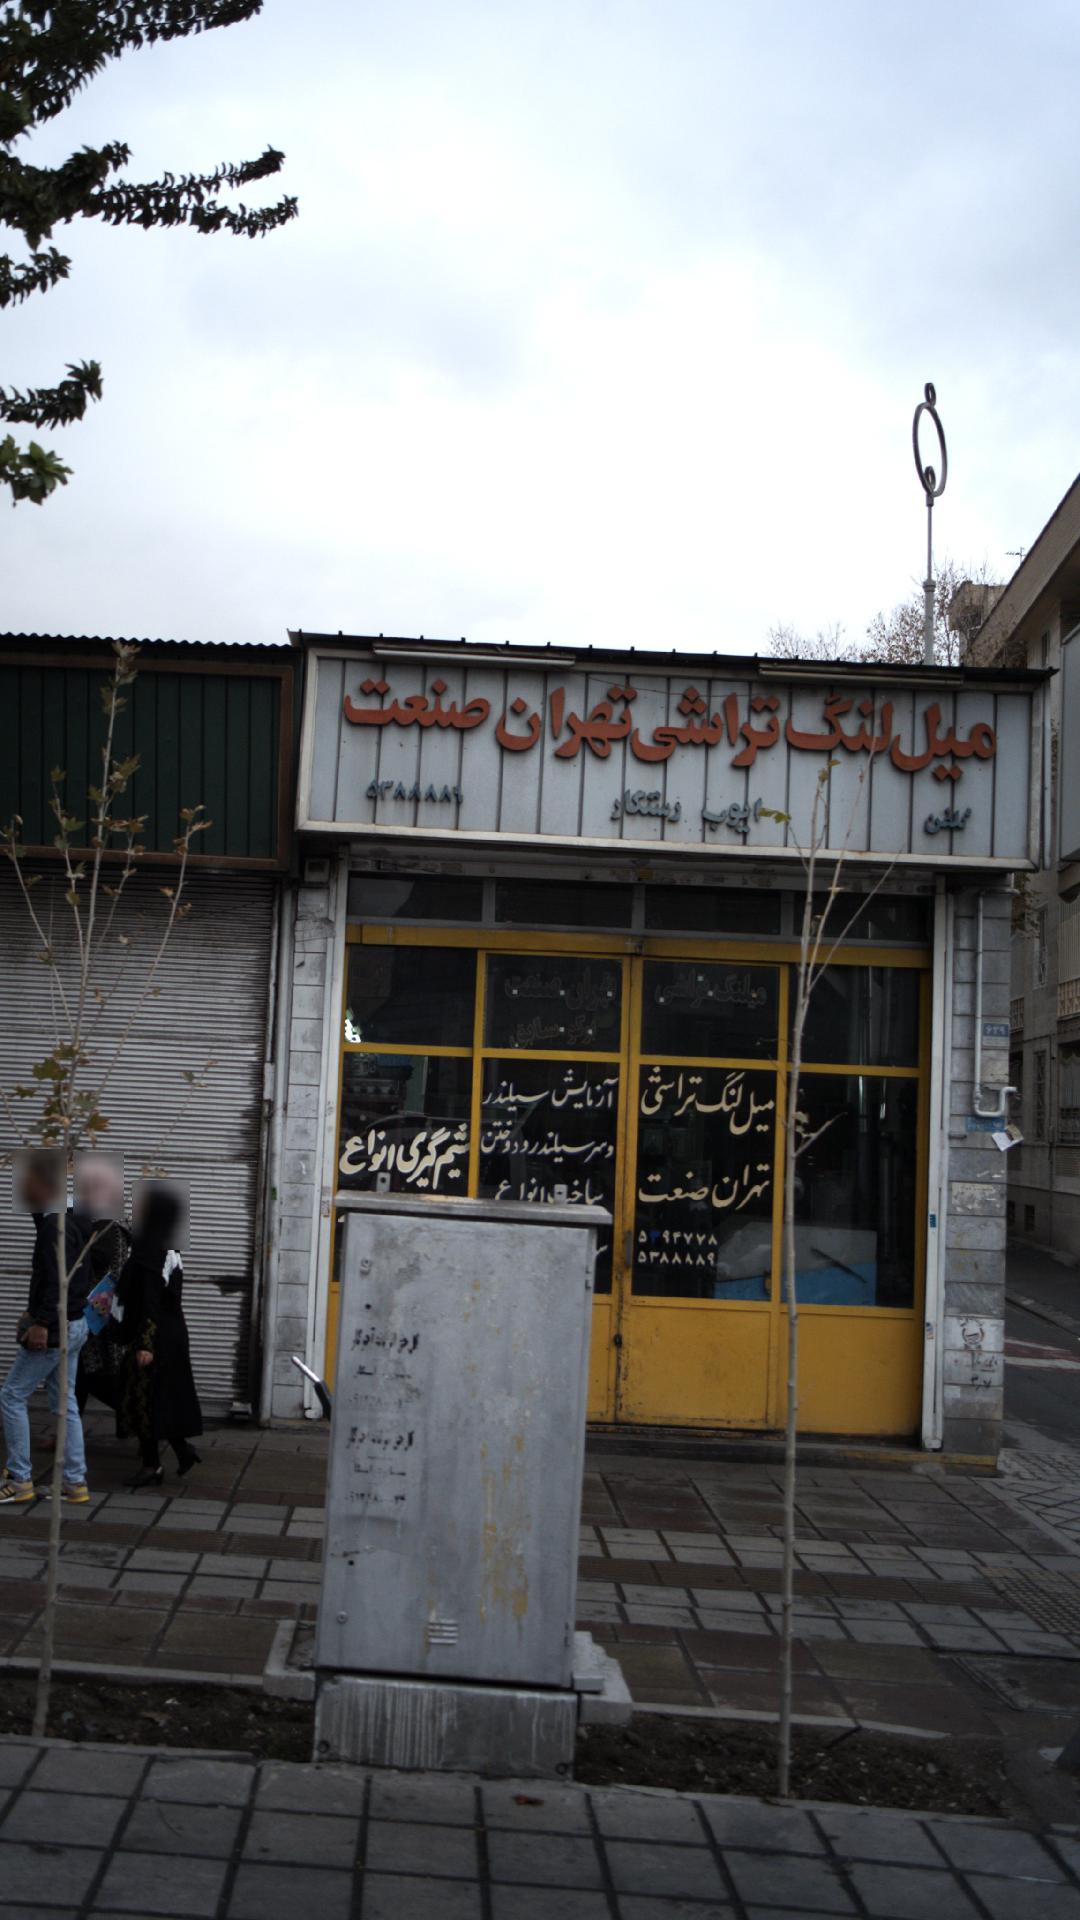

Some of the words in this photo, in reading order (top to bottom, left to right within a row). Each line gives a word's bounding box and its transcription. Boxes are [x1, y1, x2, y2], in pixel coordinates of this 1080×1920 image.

[343, 677, 491, 729] صنعت
[494, 684, 638, 759] تهران
[785, 692, 895, 752] لنگ
[630, 686, 781, 769] تراشی
[890, 703, 998, 782] میل
[610, 788, 682, 823] رستگار
[702, 796, 763, 834] ایوب
[923, 806, 972, 835] تلفن
[482, 1079, 550, 1112] سیلندر
[551, 1068, 620, 1109] آزمایش
[640, 1066, 703, 1117] تراشی
[696, 1071, 745, 1114] لنگ
[729, 1090, 775, 1136] میل
[338, 1128, 396, 1175] انواع
[396, 1126, 452, 1188] گیری
[432, 1122, 471, 1190] شیم
[638, 1170, 710, 1204] صنعت
[711, 1163, 771, 1211] تهران
[636, 1249, 717, 1267] ۵۳۸۸۸۸۹
